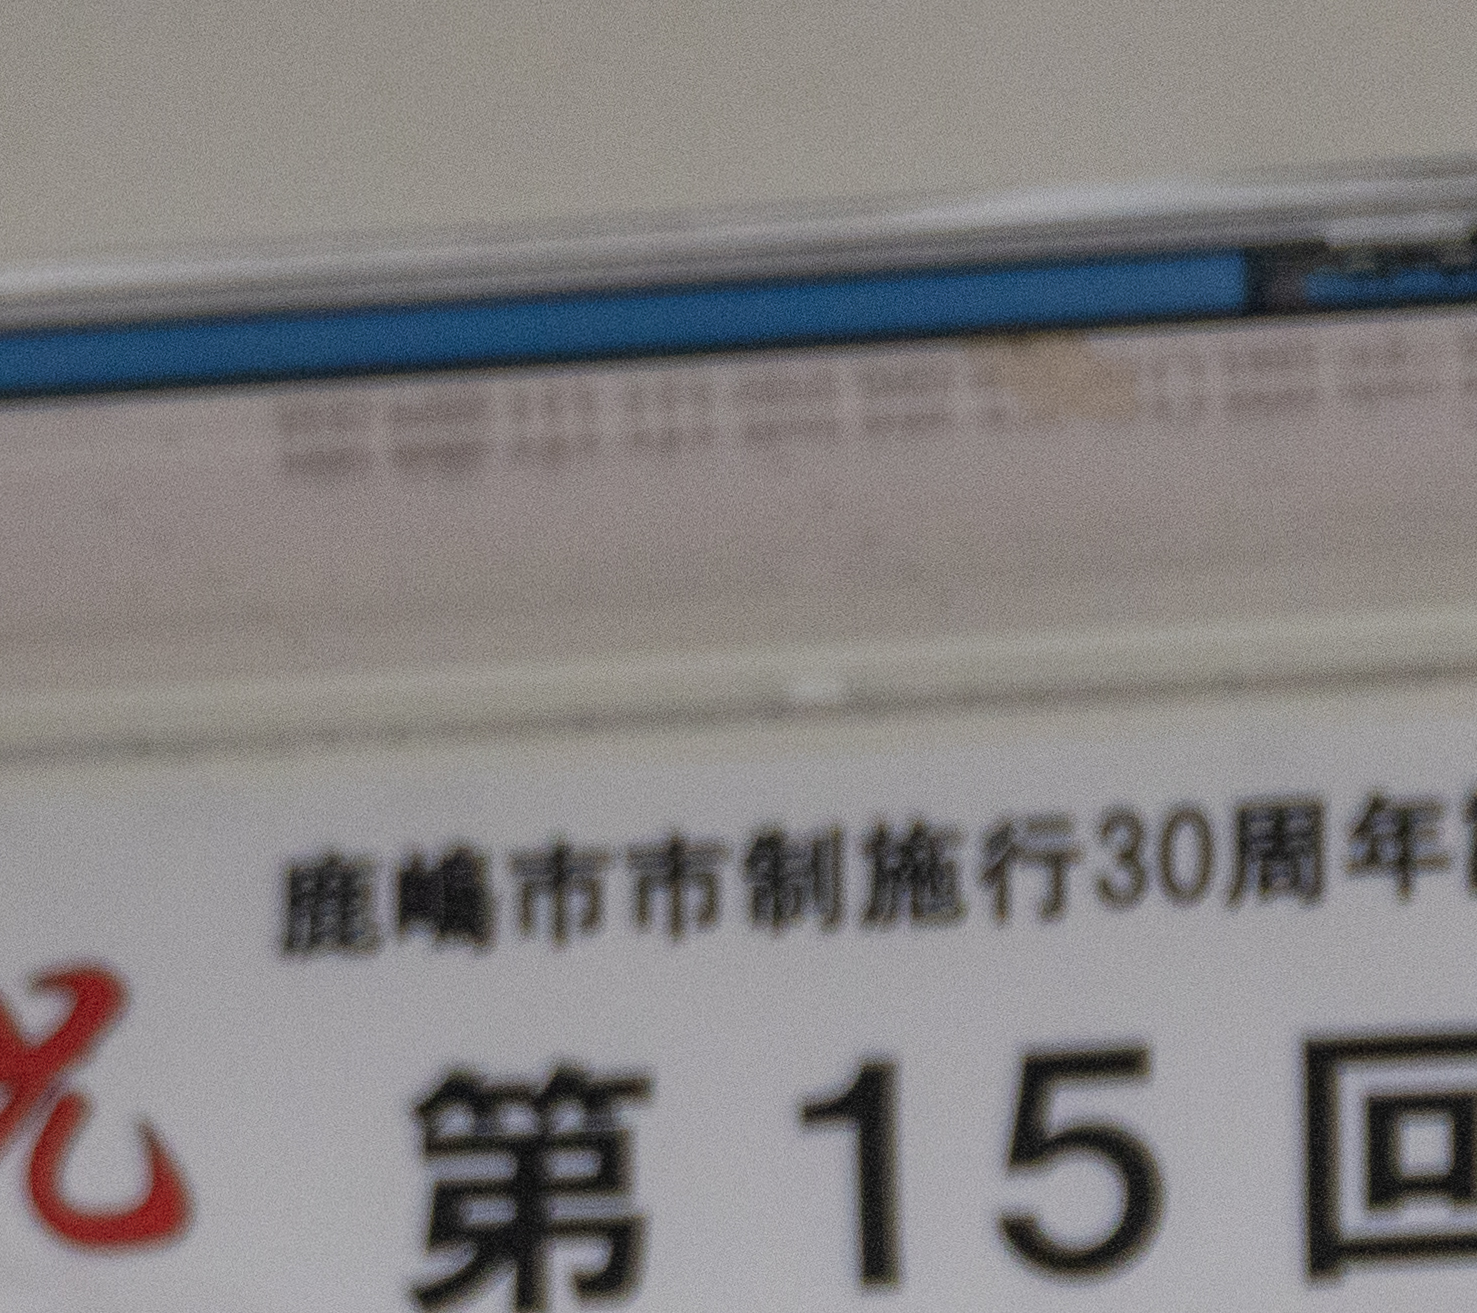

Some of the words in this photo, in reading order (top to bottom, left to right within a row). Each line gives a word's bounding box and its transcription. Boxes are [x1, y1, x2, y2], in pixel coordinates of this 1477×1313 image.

[280, 790, 1477, 957] 鹿嶋市市制施行30周年
